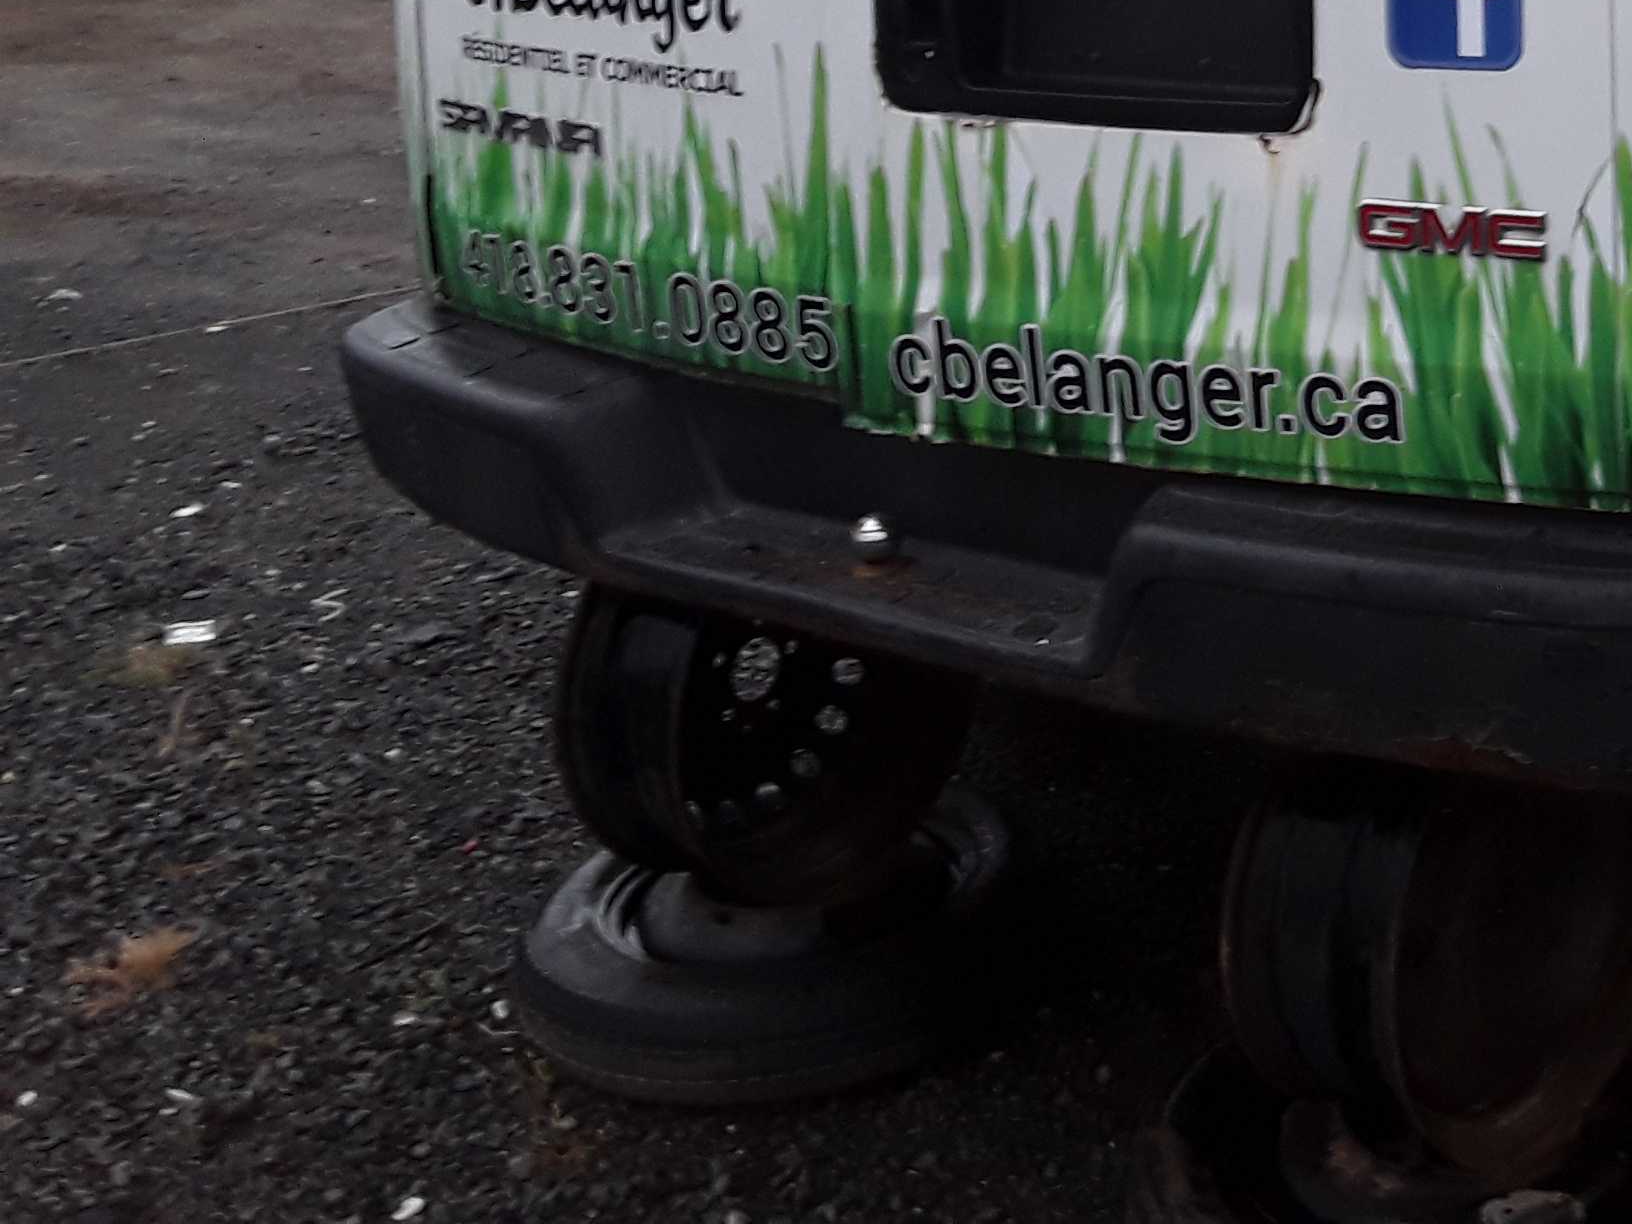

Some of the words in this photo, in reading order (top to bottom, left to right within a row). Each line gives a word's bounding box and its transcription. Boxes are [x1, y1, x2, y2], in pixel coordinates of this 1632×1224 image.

[577, 54, 597, 76] ET
[601, 57, 744, 96] COMMERCIAL
[1358, 197, 1548, 262] GMC
[462, 228, 838, 371] 418.831.0885
[888, 316, 1406, 445] cbelanger.ca
